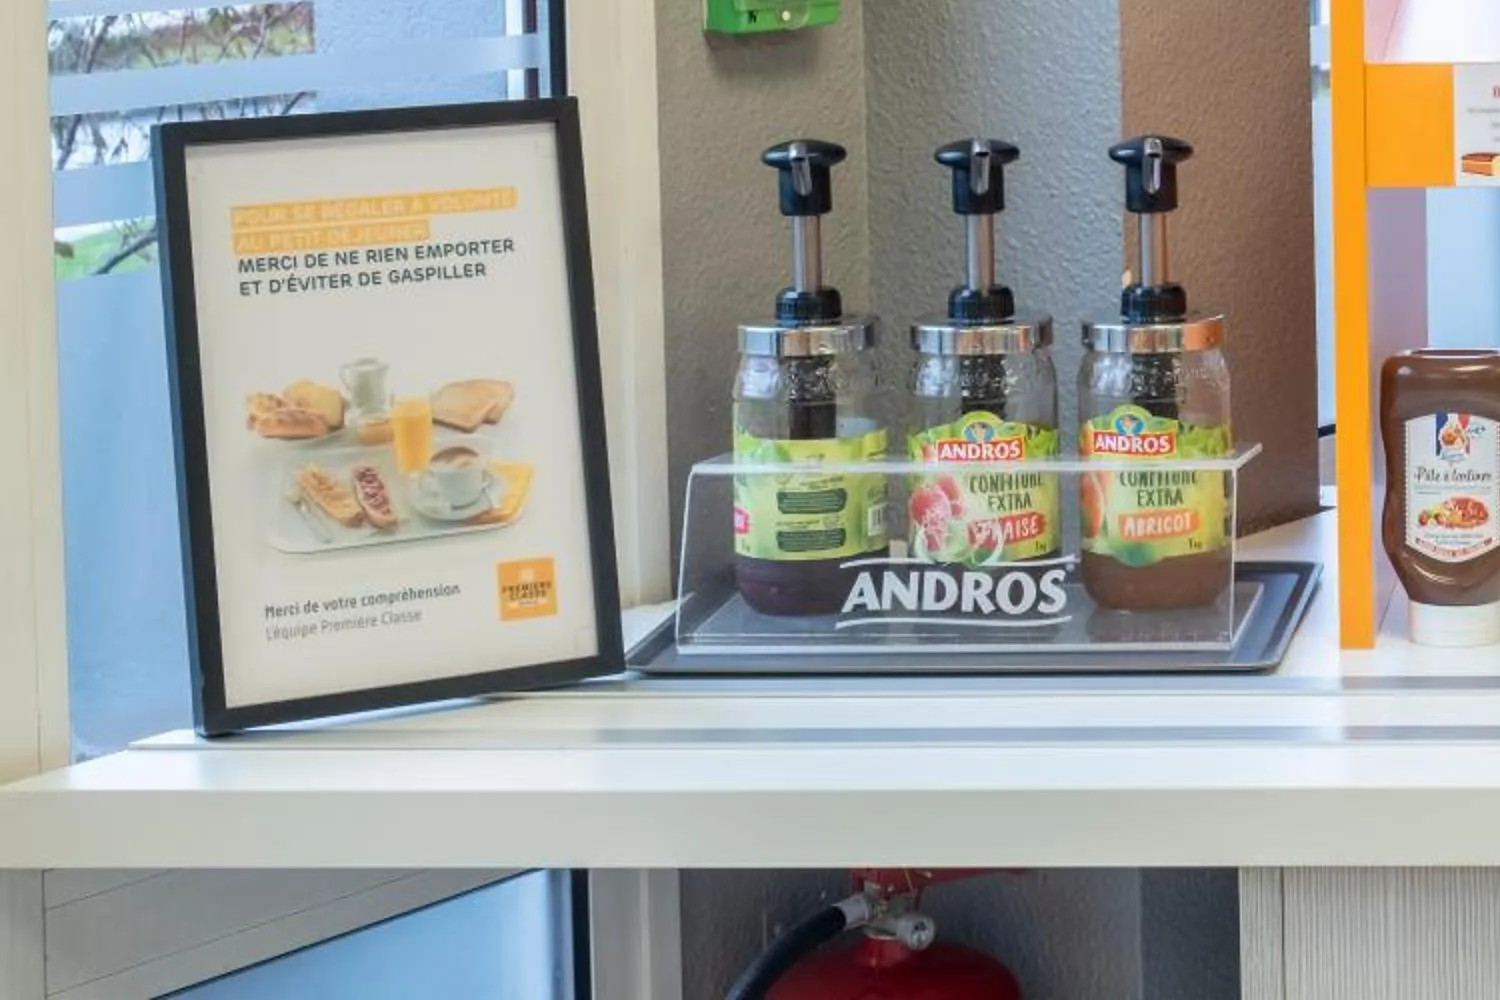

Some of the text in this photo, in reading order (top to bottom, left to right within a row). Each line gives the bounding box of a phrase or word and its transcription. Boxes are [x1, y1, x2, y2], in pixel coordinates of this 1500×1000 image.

[238, 238, 514, 274] MERCI DE NE RIEN EMPORTER
[239, 262, 487, 296] ET D'ÉVITER DE GASPILLER
[940, 440, 1020, 460] ANDROS
[1095, 435, 1171, 453] ANDROS
[988, 491, 1032, 511] EXTRA
[1137, 488, 1184, 507] EXTRA
[1124, 512, 1191, 538] ABRICOT
[265, 584, 461, 619] Merci de votre compréhension
[841, 570, 1068, 615] ANDROS
